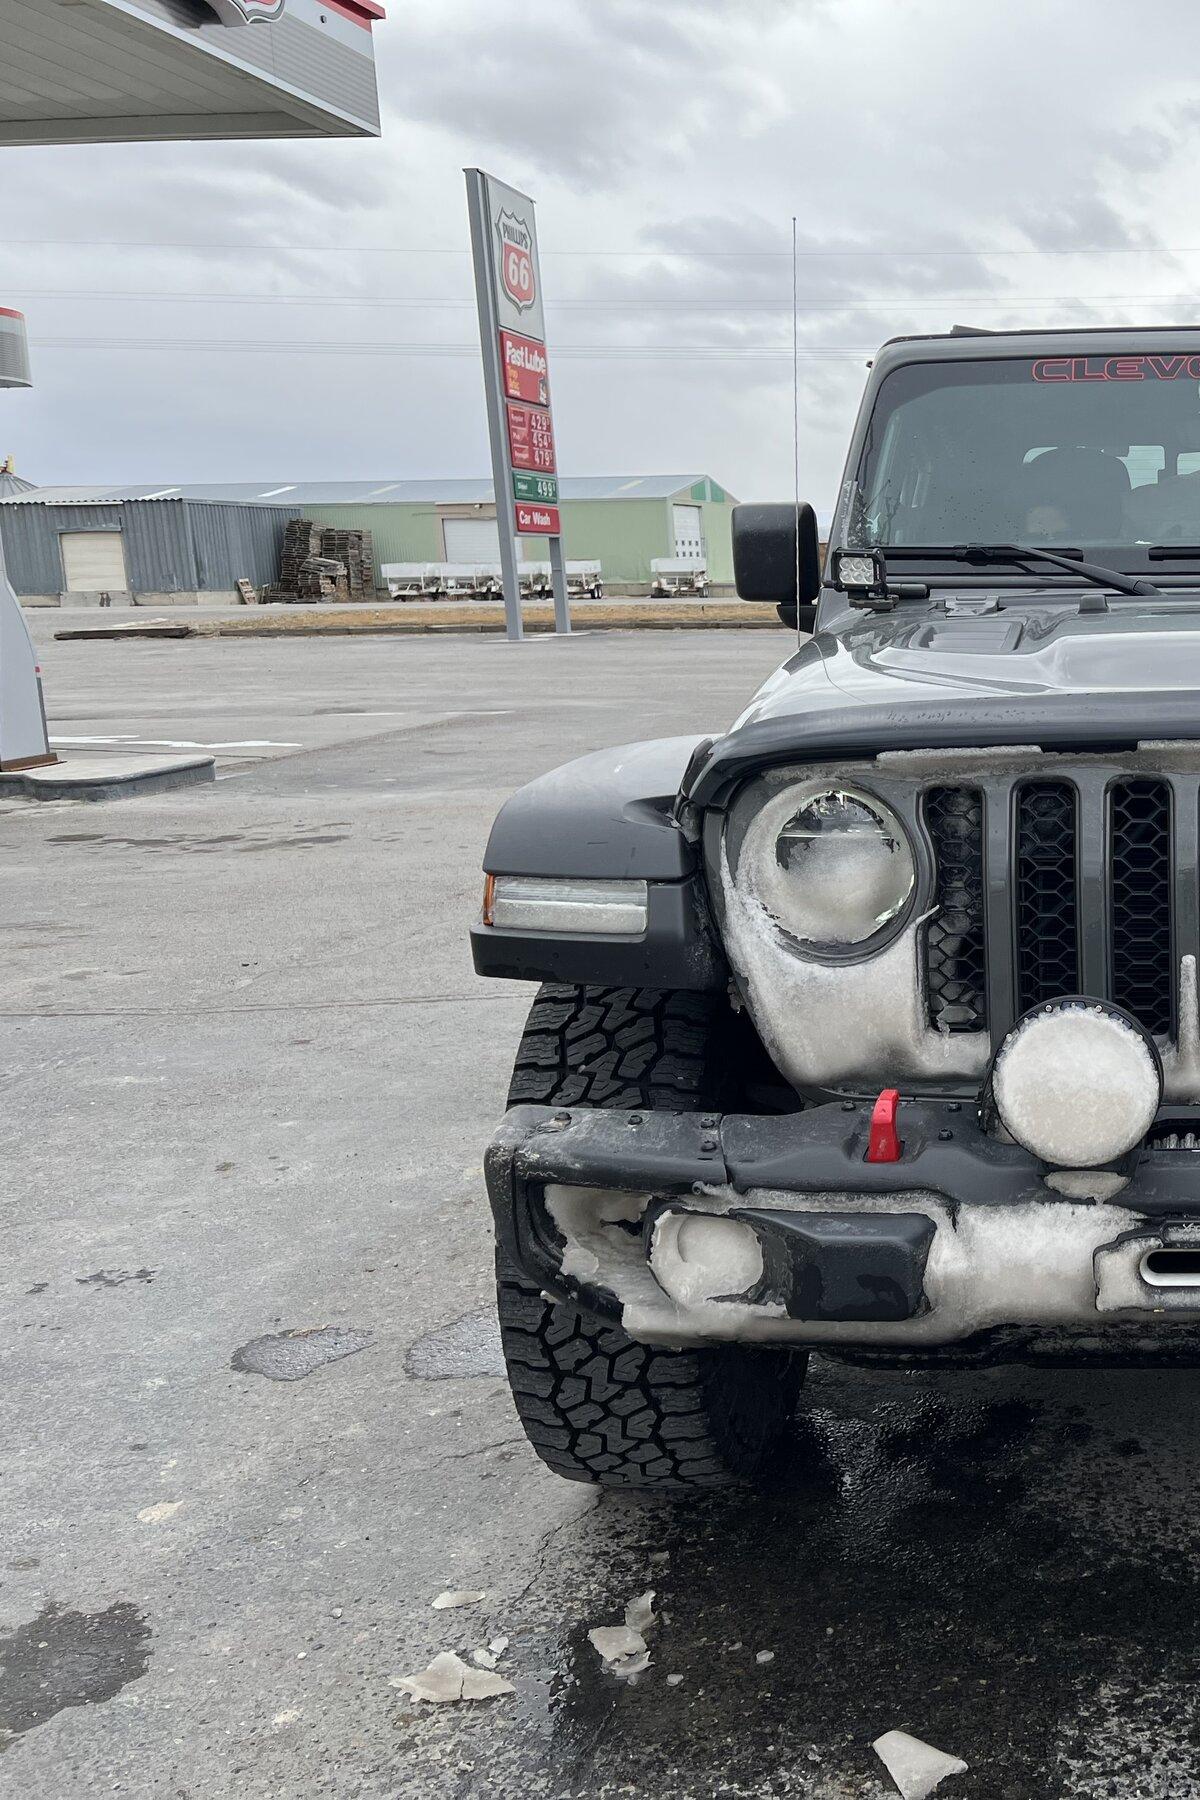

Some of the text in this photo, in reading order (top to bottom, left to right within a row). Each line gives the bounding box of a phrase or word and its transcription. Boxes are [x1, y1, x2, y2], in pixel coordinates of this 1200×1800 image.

[503, 222, 528, 249] PHILLIPS
[508, 252, 529, 290] 66
[519, 510, 551, 526] Car Wash
